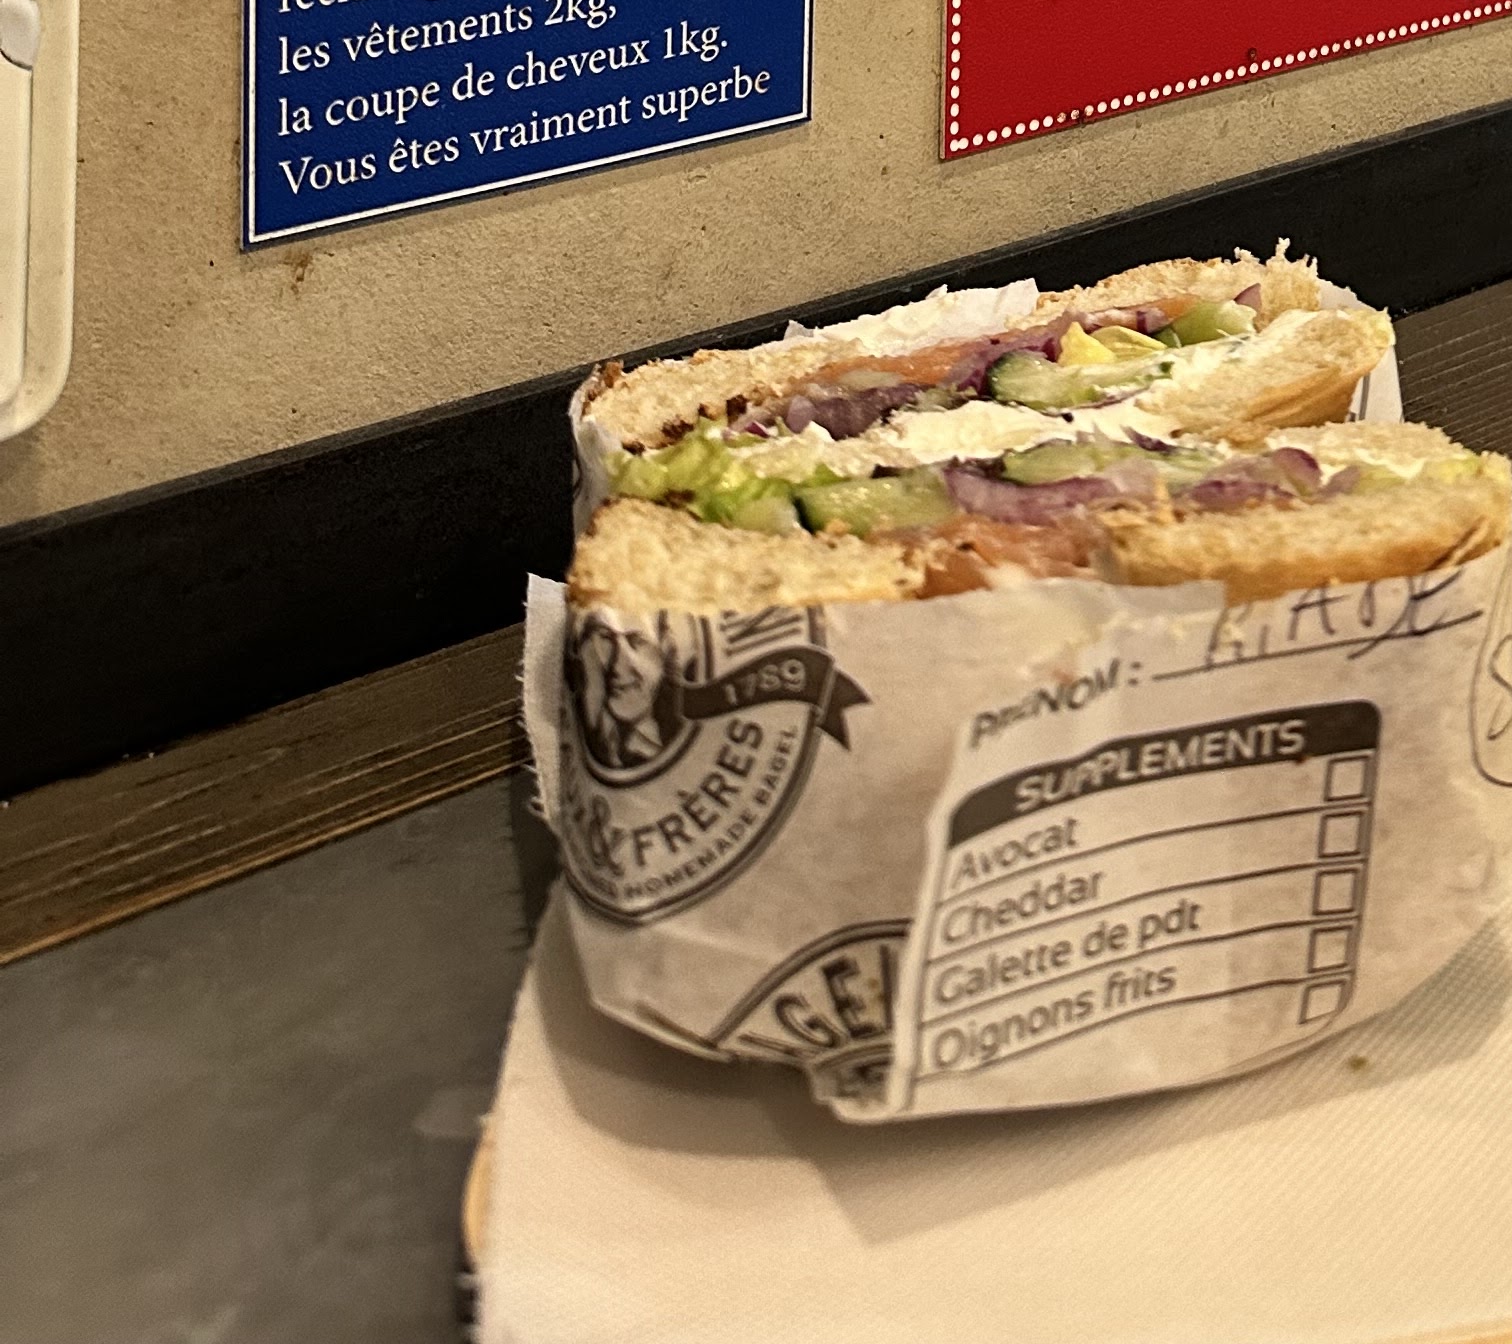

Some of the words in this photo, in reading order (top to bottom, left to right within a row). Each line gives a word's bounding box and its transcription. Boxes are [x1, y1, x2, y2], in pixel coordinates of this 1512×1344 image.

[278, 36, 330, 74] les
[342, 4, 532, 61] vêtements
[278, 97, 312, 136] la
[325, 81, 440, 125] coupe
[452, 62, 494, 101] de
[506, 40, 650, 90] cheveux
[663, 20, 726, 62] 1kg.
[278, 153, 376, 194] Vous
[388, 136, 459, 173] êtes
[470, 95, 631, 154] vraiment
[642, 65, 770, 122] superbe
[724, 659, 806, 705] 1789
[633, 718, 764, 867] FRÈRES
[1016, 719, 1307, 812] SUPPLEMENTS
[951, 818, 1079, 889] Avocat
[935, 942, 1073, 1007] Galette
[1082, 915, 1128, 957] de
[1138, 898, 1201, 949] pdt
[942, 872, 1104, 944] Cheddar
[934, 988, 1095, 1070] Oignons
[1104, 967, 1177, 1011] frits
